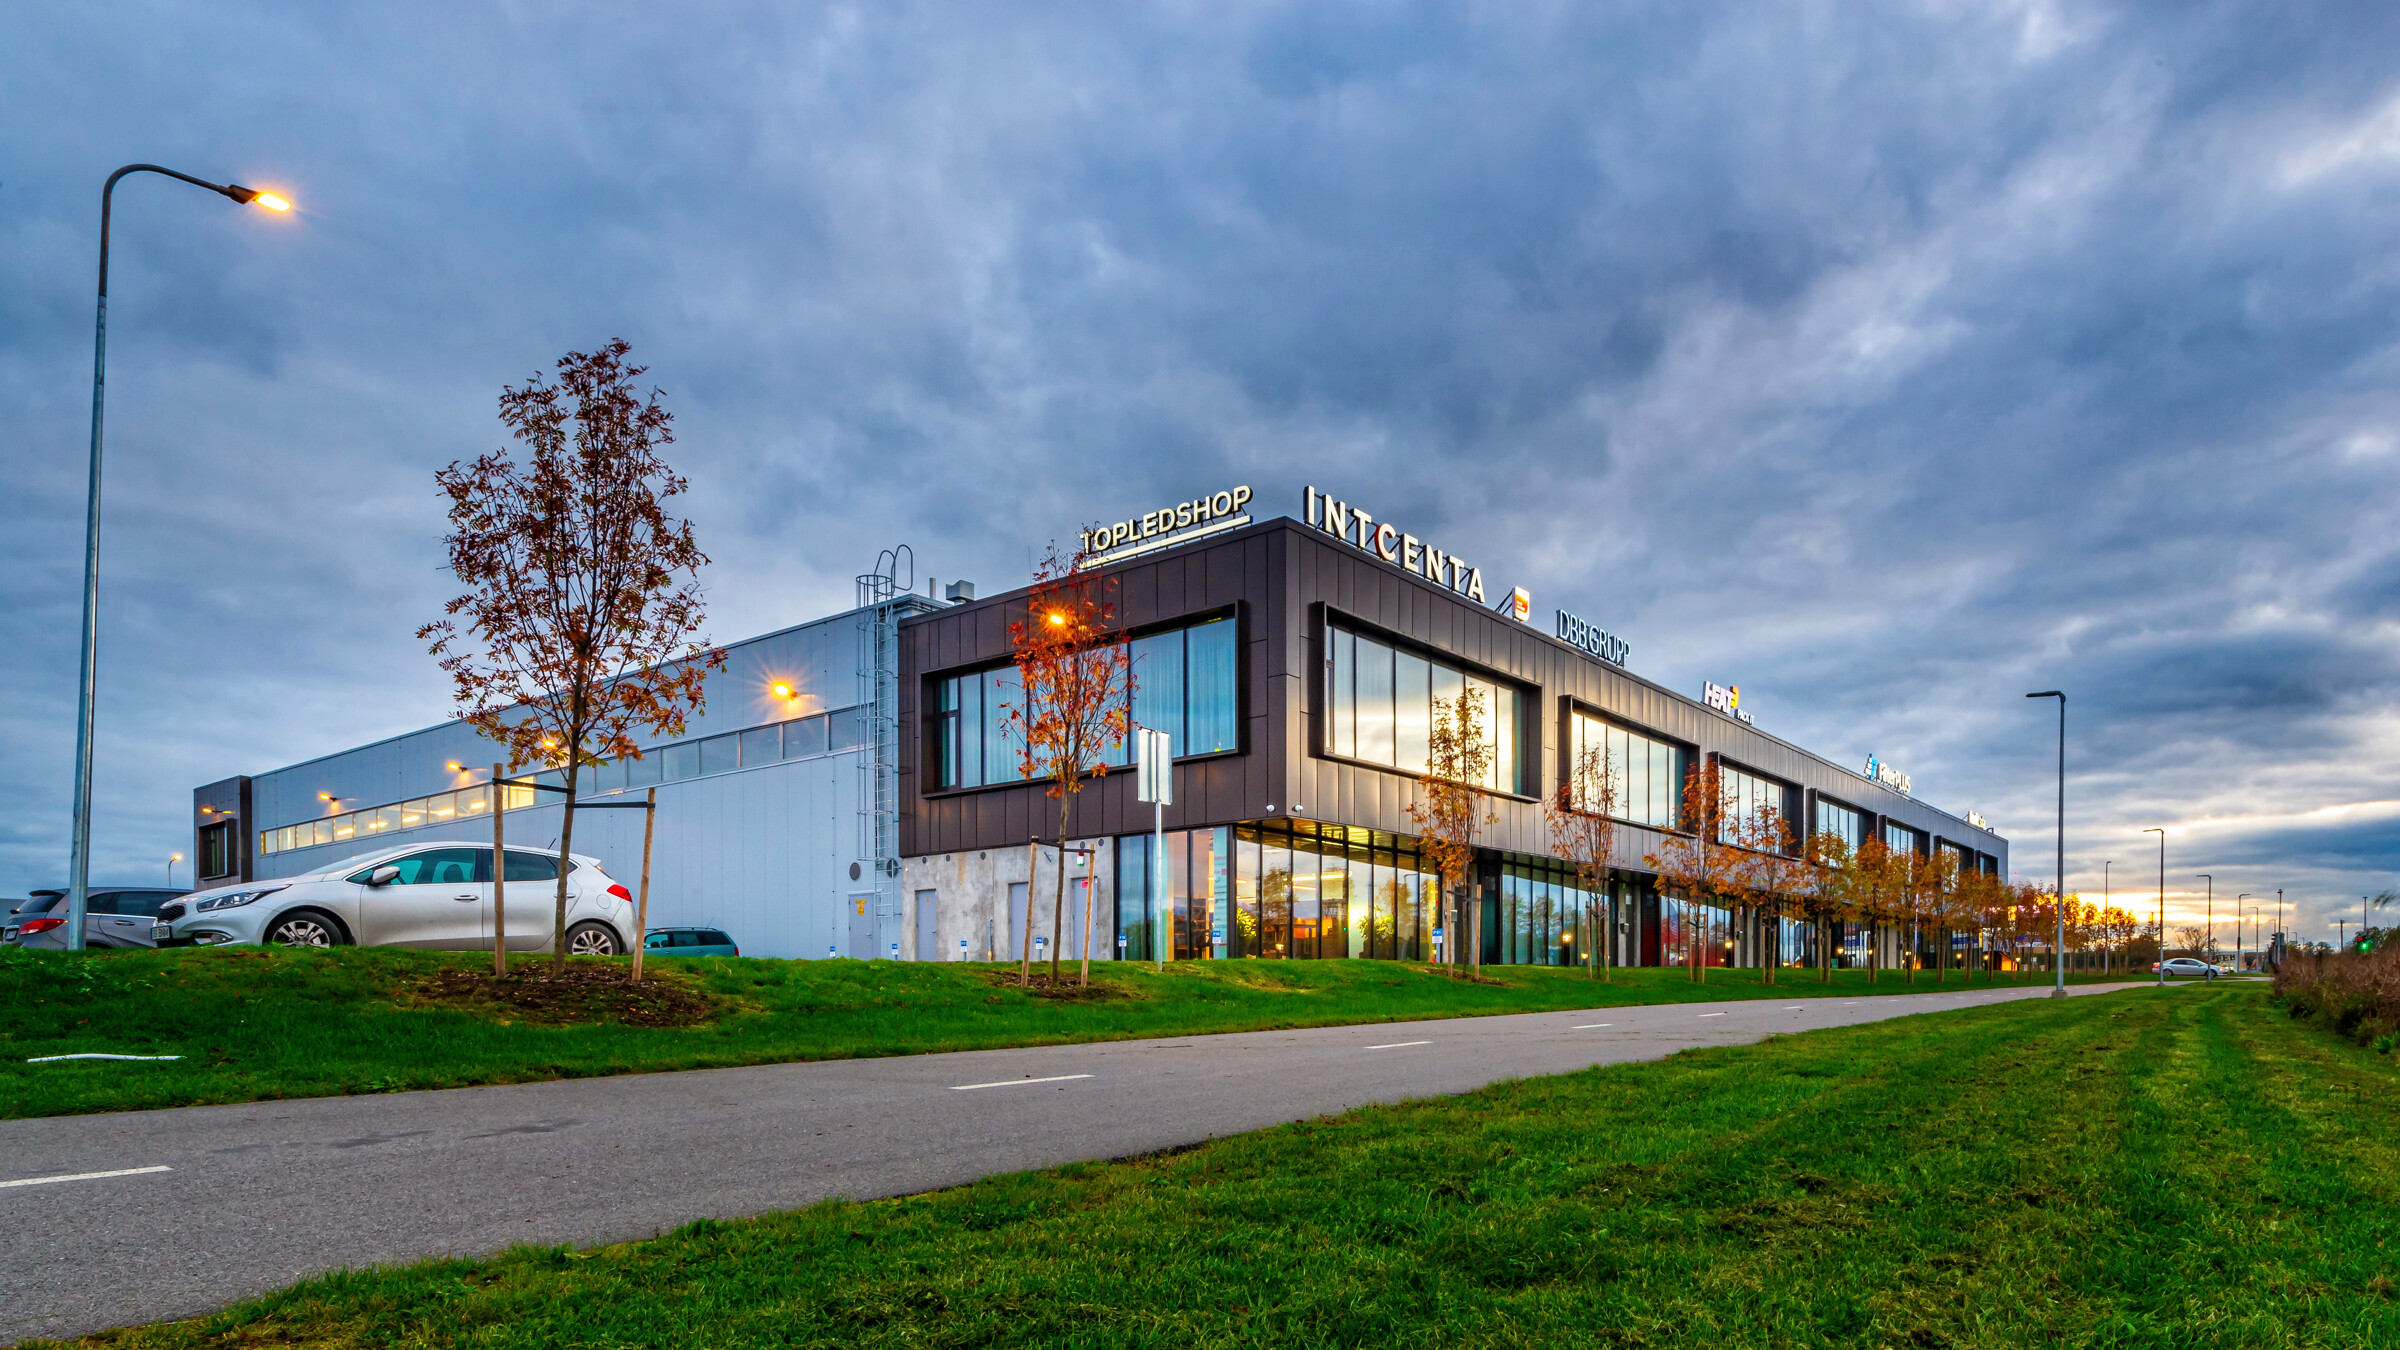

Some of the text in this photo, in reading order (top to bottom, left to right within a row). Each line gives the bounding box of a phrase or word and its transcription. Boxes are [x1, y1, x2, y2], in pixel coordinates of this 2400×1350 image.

[1079, 485, 1252, 555] TOPLEDSHOP
[1304, 485, 1485, 603] INTCENTA
[1558, 609, 1631, 667] DBB GRUPP
